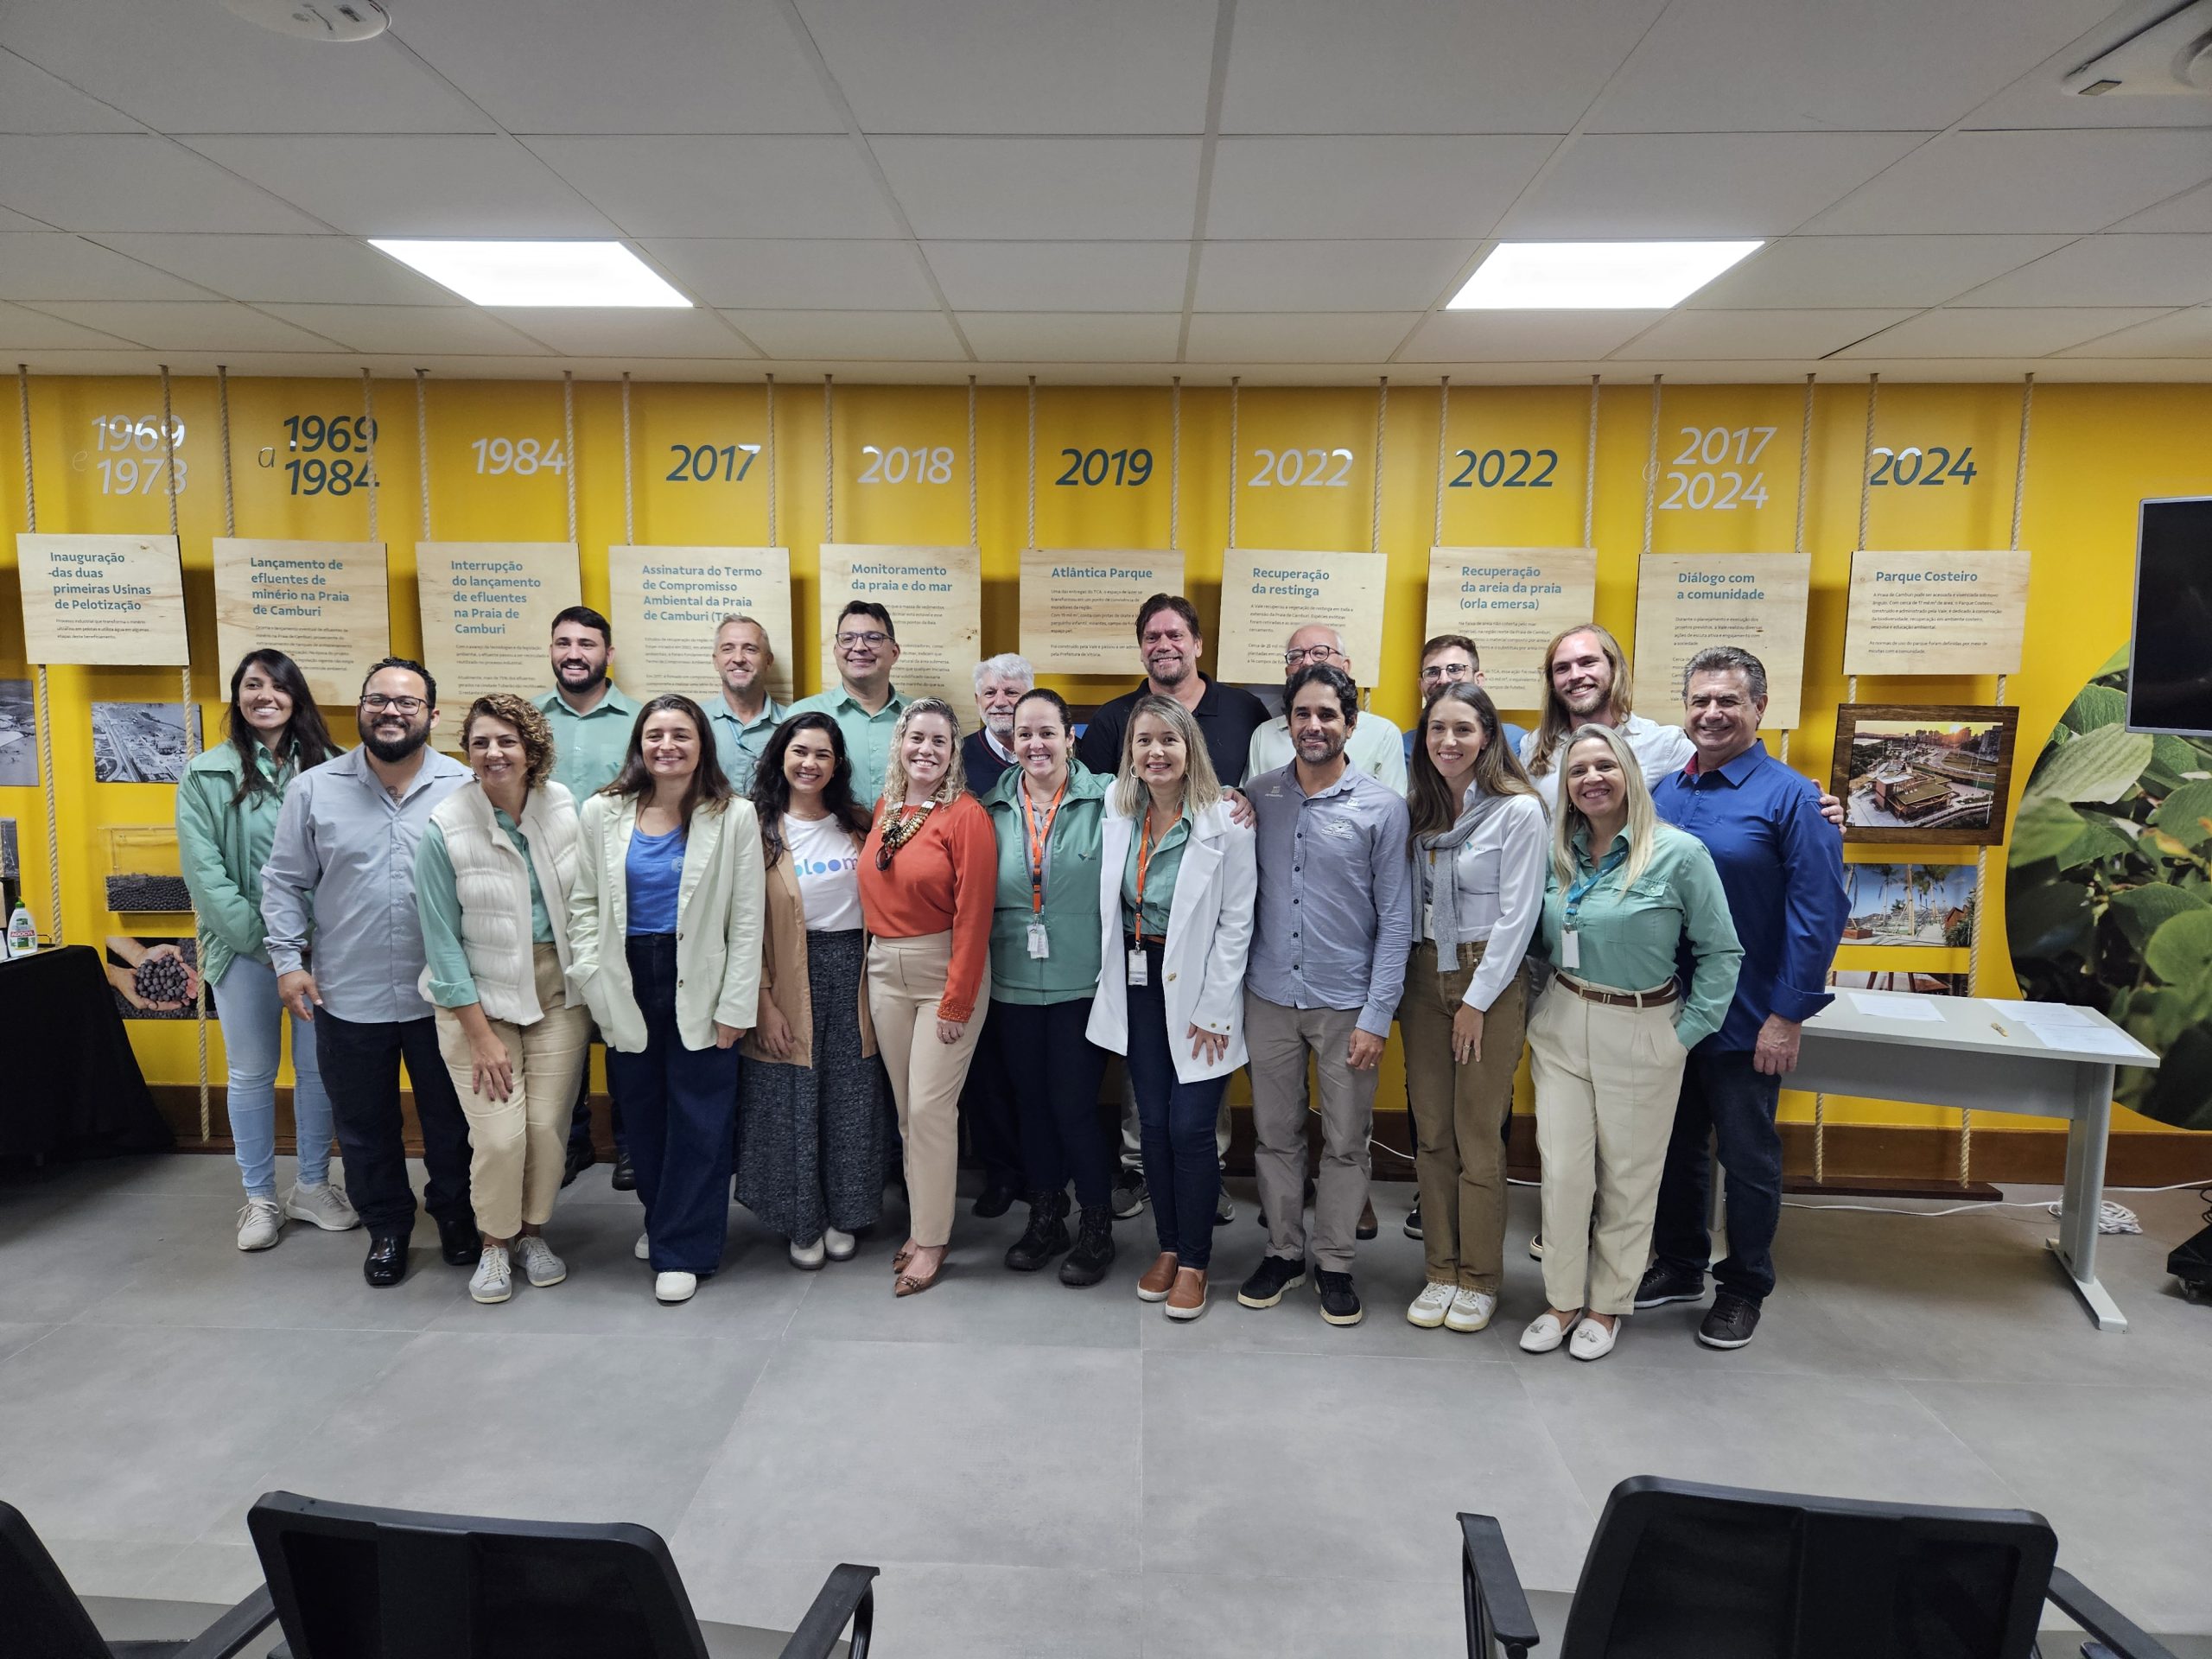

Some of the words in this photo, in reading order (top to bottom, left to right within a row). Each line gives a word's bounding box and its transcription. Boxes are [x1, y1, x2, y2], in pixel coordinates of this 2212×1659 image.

[92, 415, 185, 452] 1969
[283, 415, 378, 453] 1969
[1673, 427, 1777, 464] 2017
[472, 438, 566, 475] 1984
[666, 445, 760, 481] 2017
[858, 446, 954, 484] 2018
[1055, 449, 1153, 486] 2019
[1248, 449, 1353, 486] 2022
[1448, 449, 1558, 487] 2022
[1870, 448, 1977, 486] 2024
[97, 458, 188, 494] 1973
[285, 459, 379, 496] 1984
[1659, 472, 1769, 510] 2024
[51, 552, 124, 564] Inauguração
[251, 557, 325, 570] Lançamento
[328, 560, 343, 569] de
[76, 568, 103, 577] duas
[452, 561, 523, 573] Interrupção
[643, 565, 704, 575] Assinatura
[708, 566, 721, 575] do
[725, 567, 761, 576] Termo
[852, 563, 946, 575] Monitoramento
[1462, 567, 1541, 579] Recuperação
[251, 573, 308, 584] efluentes
[312, 575, 326, 584] de
[1052, 567, 1106, 577] Atlântica
[1110, 569, 1152, 581] Parque
[1253, 569, 1329, 582] Recuperação
[1679, 572, 1726, 585] Diálogo
[1876, 572, 1921, 584] Parque
[1925, 571, 1978, 582] Costeiro
[453, 576, 467, 586] do
[470, 576, 540, 588] lançamento
[643, 580, 656, 589] de
[659, 581, 737, 593] Compromisso
[852, 579, 865, 589] da
[869, 580, 899, 592] praia
[912, 581, 925, 591] do
[1461, 582, 1476, 592] da
[1479, 582, 1509, 593] areia
[1513, 582, 1527, 593] da
[1530, 583, 1561, 595] praia
[54, 583, 110, 595] primeiras
[113, 584, 151, 594] Usinas
[252, 589, 297, 600] minério
[319, 591, 349, 601] Praia
[1252, 583, 1266, 594] da
[1269, 585, 1319, 598] restinga
[1688, 588, 1764, 600] comunidade
[454, 592, 467, 601] de
[471, 592, 526, 602] efluentes
[644, 595, 702, 605] Ambiental
[706, 596, 719, 606] da
[723, 597, 752, 607] Praia
[55, 600, 69, 609] de
[73, 600, 141, 613] Pelotização
[253, 605, 267, 614] de
[270, 606, 321, 616] Camburi
[1460, 598, 1487, 610] (orla
[1491, 599, 1539, 610] emersa)
[472, 608, 502, 618] Praia
[505, 608, 519, 618] de
[644, 610, 657, 620] de
[661, 611, 709, 621] Camburi
[455, 624, 505, 634] Camburi
